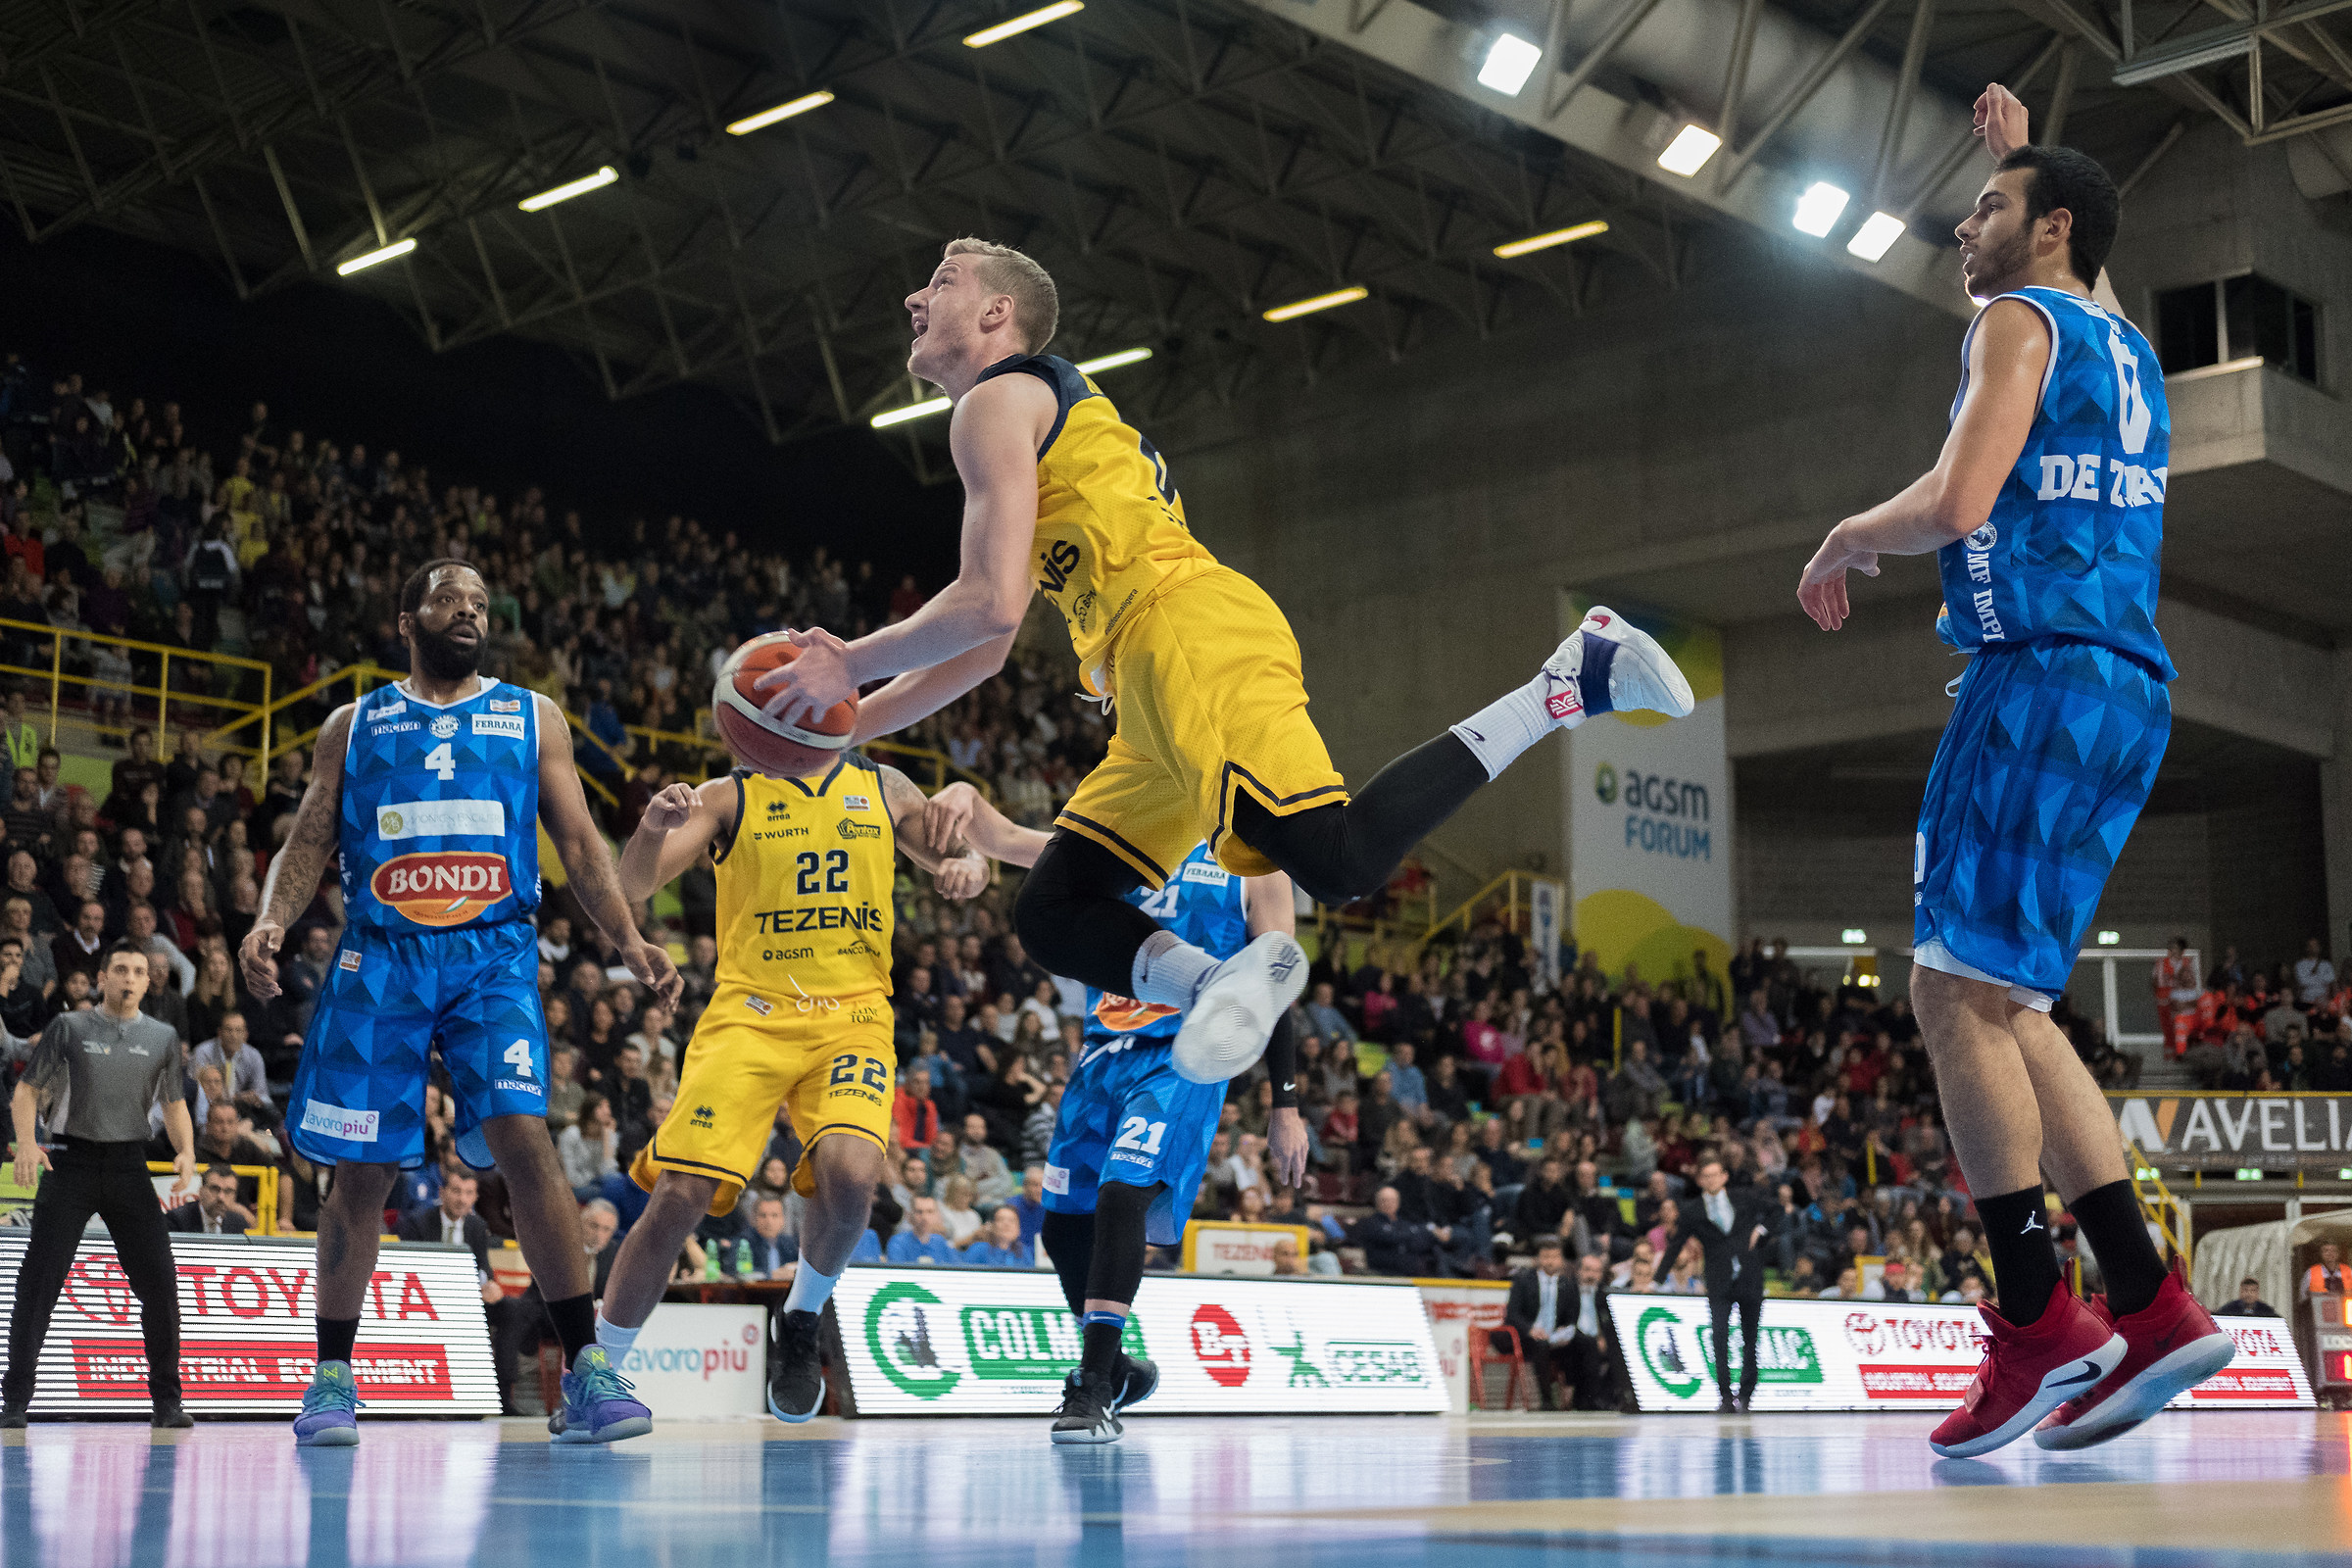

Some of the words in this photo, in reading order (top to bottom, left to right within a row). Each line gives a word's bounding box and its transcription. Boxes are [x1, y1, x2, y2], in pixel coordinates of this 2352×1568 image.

[2037, 454, 2100, 501] DE
[1967, 552, 1991, 584] MF
[474, 719, 522, 733] FERRARA
[424, 743, 456, 780] 4
[1624, 769, 1709, 822] agsm
[1624, 815, 1711, 861] FORUM
[387, 865, 502, 895] BONDI
[797, 849, 849, 895] 22
[1186, 867, 1226, 879] FERRARA
[1139, 885, 1180, 917] 21
[503, 1039, 533, 1077] 4
[830, 1054, 887, 1095] 22
[1114, 1116, 1167, 1155] 21
[2180, 1098, 2352, 1152] AVELI
[176, 1264, 440, 1321] TOYTA
[88, 1356, 269, 1384] INDTRIAL
[620, 1339, 749, 1382] avoropiu
